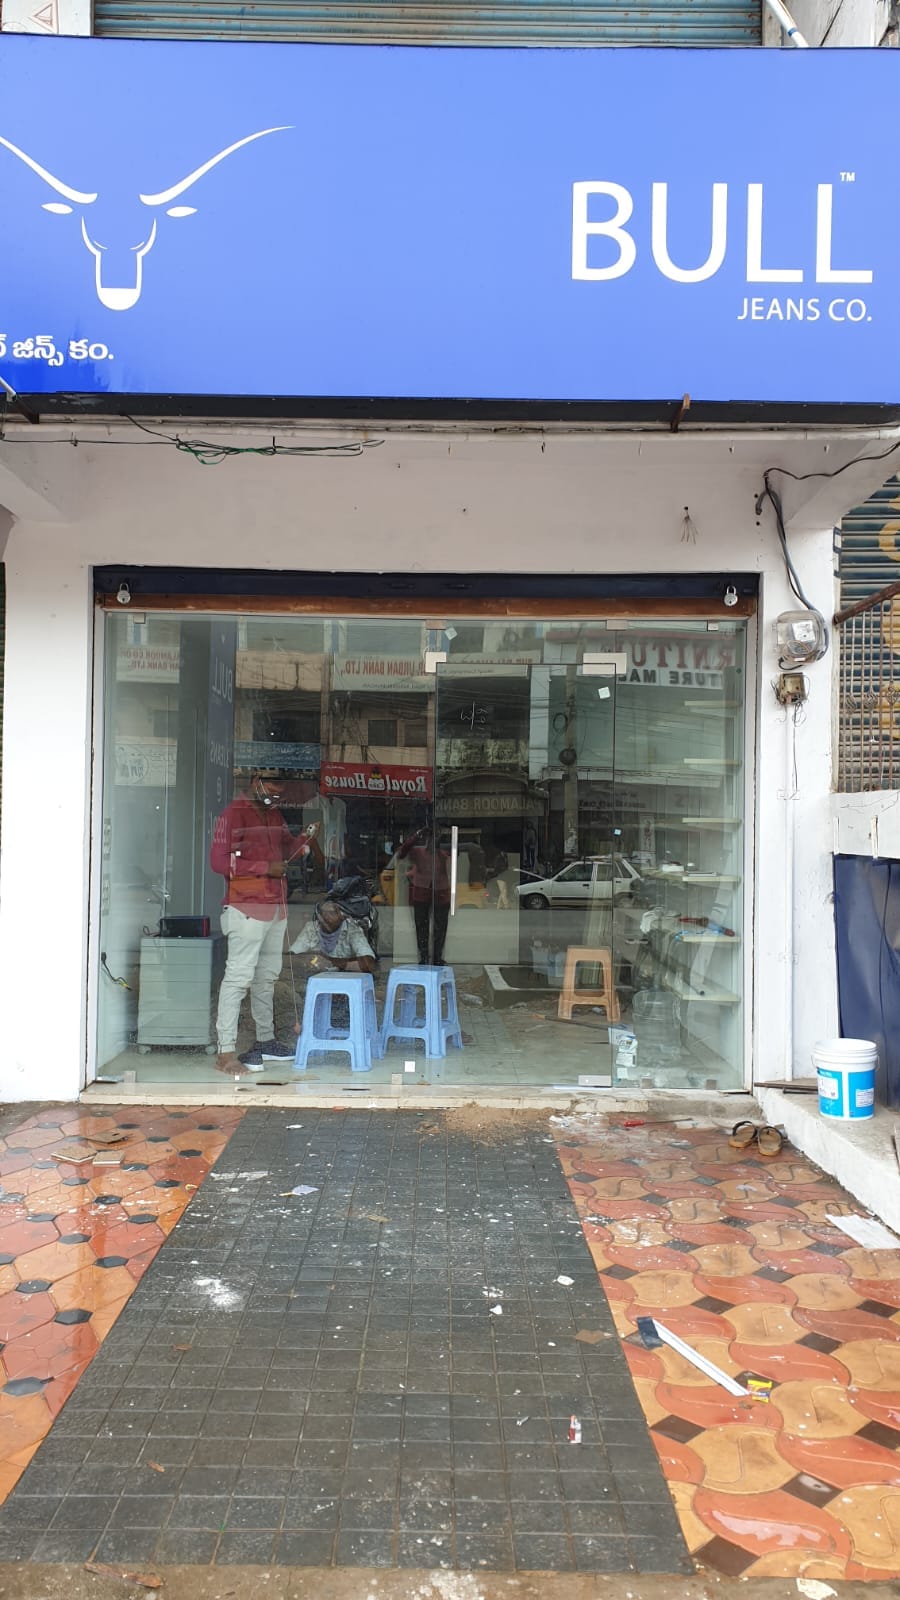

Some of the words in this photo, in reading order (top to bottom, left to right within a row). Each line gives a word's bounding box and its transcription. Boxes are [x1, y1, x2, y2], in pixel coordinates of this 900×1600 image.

[572, 181, 873, 283] BULL
[840, 172, 856, 182] TM
[737, 298, 820, 322] JEANS
[828, 298, 873, 323] CO.
